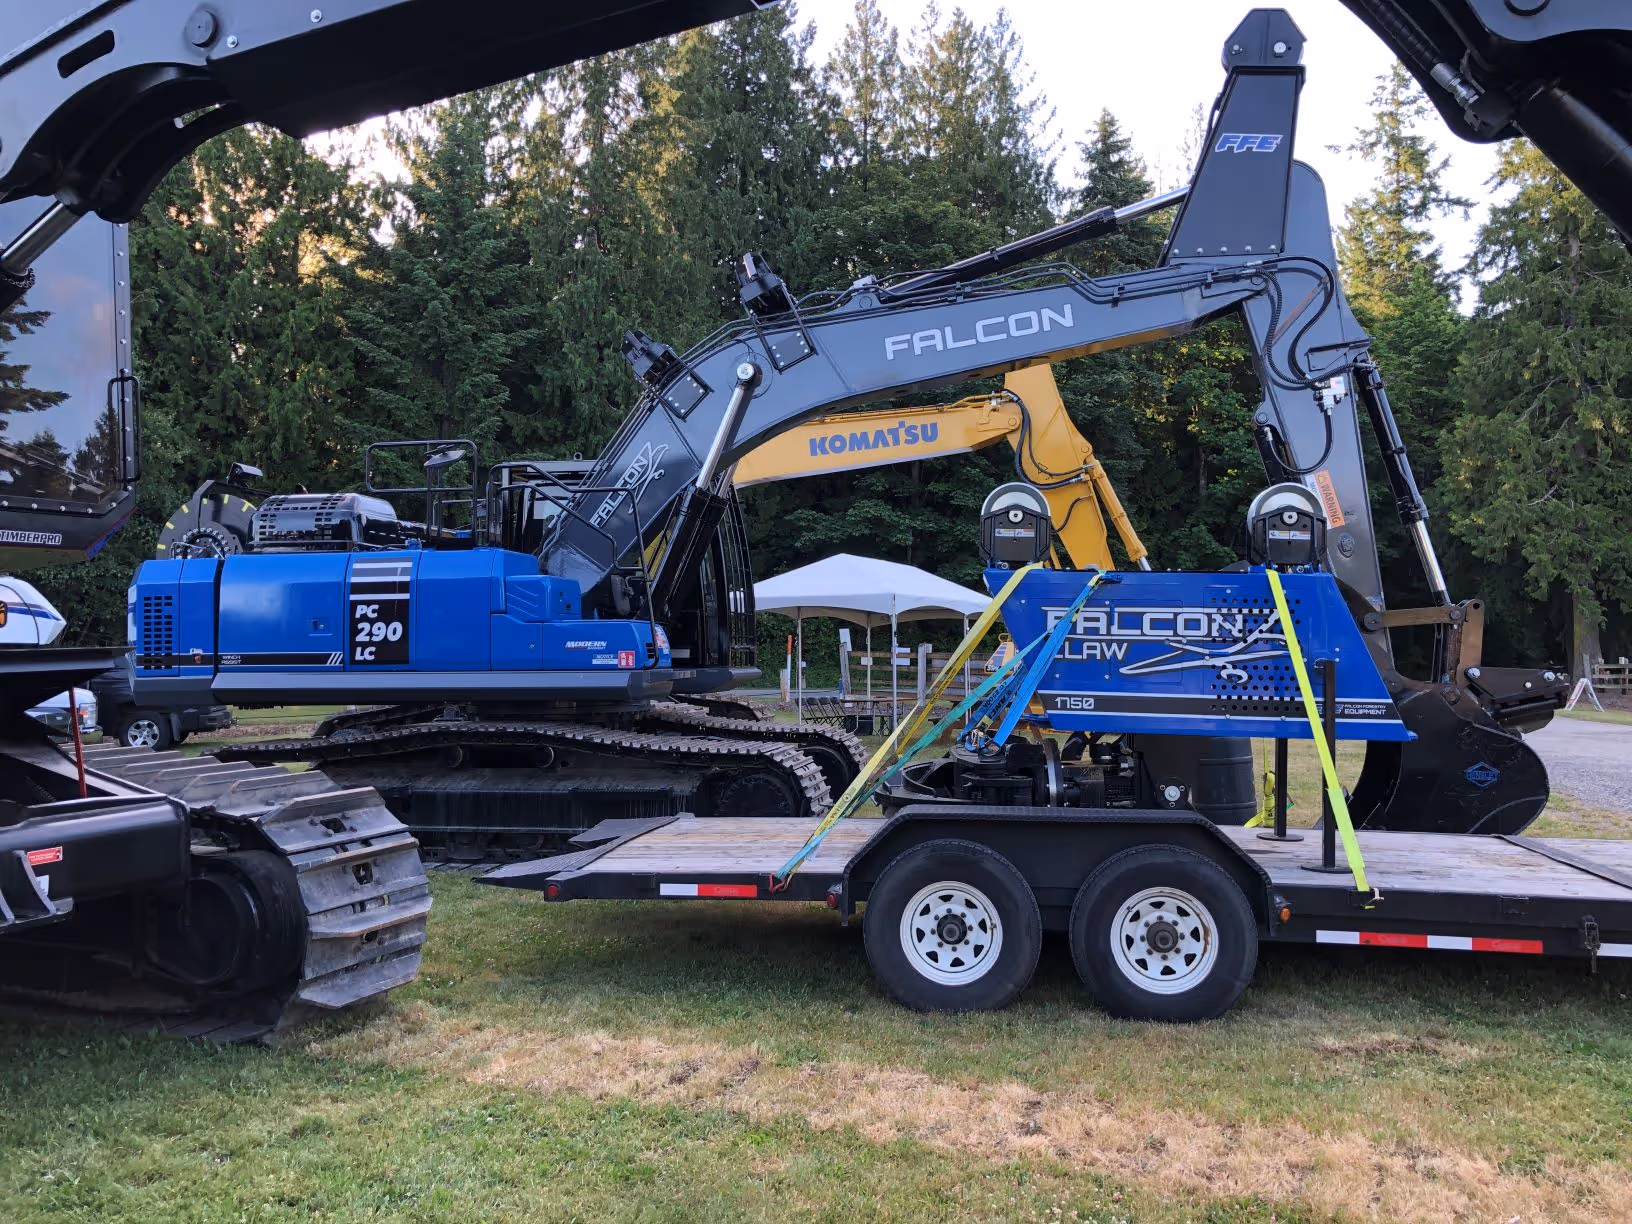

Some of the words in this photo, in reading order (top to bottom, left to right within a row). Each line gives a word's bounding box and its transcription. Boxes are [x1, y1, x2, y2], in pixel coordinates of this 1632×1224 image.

[1215, 133, 1283, 153] FFE
[884, 303, 1075, 361] FALCON
[809, 420, 938, 457] KOMATSU
[590, 455, 649, 528] FALCON
[1320, 483, 1342, 524] WARNING
[0, 529, 62, 545] TIMBERPRO
[355, 604, 379, 618] PC
[355, 621, 403, 642] 290
[1046, 611, 1243, 637] FALCON
[355, 646, 376, 660] LC
[1055, 641, 1128, 660] LAW
[1054, 696, 1095, 709] 1750
